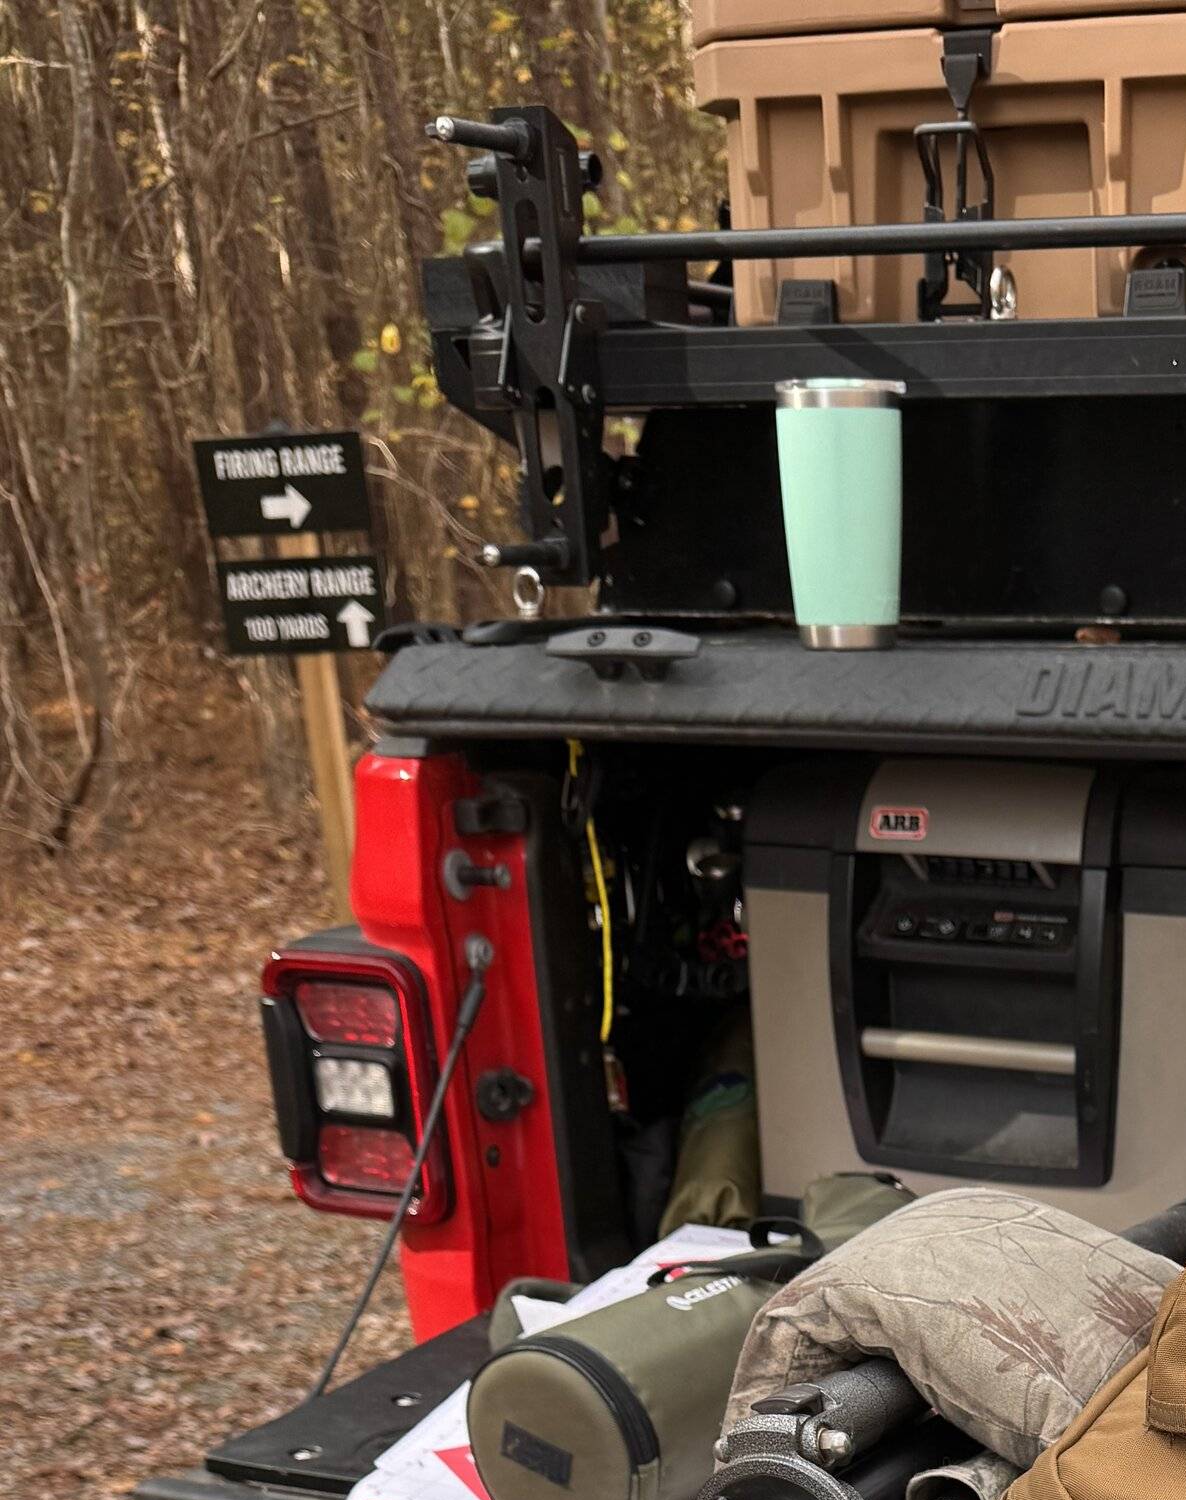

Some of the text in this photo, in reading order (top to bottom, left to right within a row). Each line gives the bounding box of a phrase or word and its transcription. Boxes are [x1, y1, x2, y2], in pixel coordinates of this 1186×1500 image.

[213, 443, 347, 481] FIRING RANGE
[227, 565, 377, 601] ARCHERY RANGE
[243, 612, 331, 642] 100 YARDS
[879, 814, 920, 832] ARB
